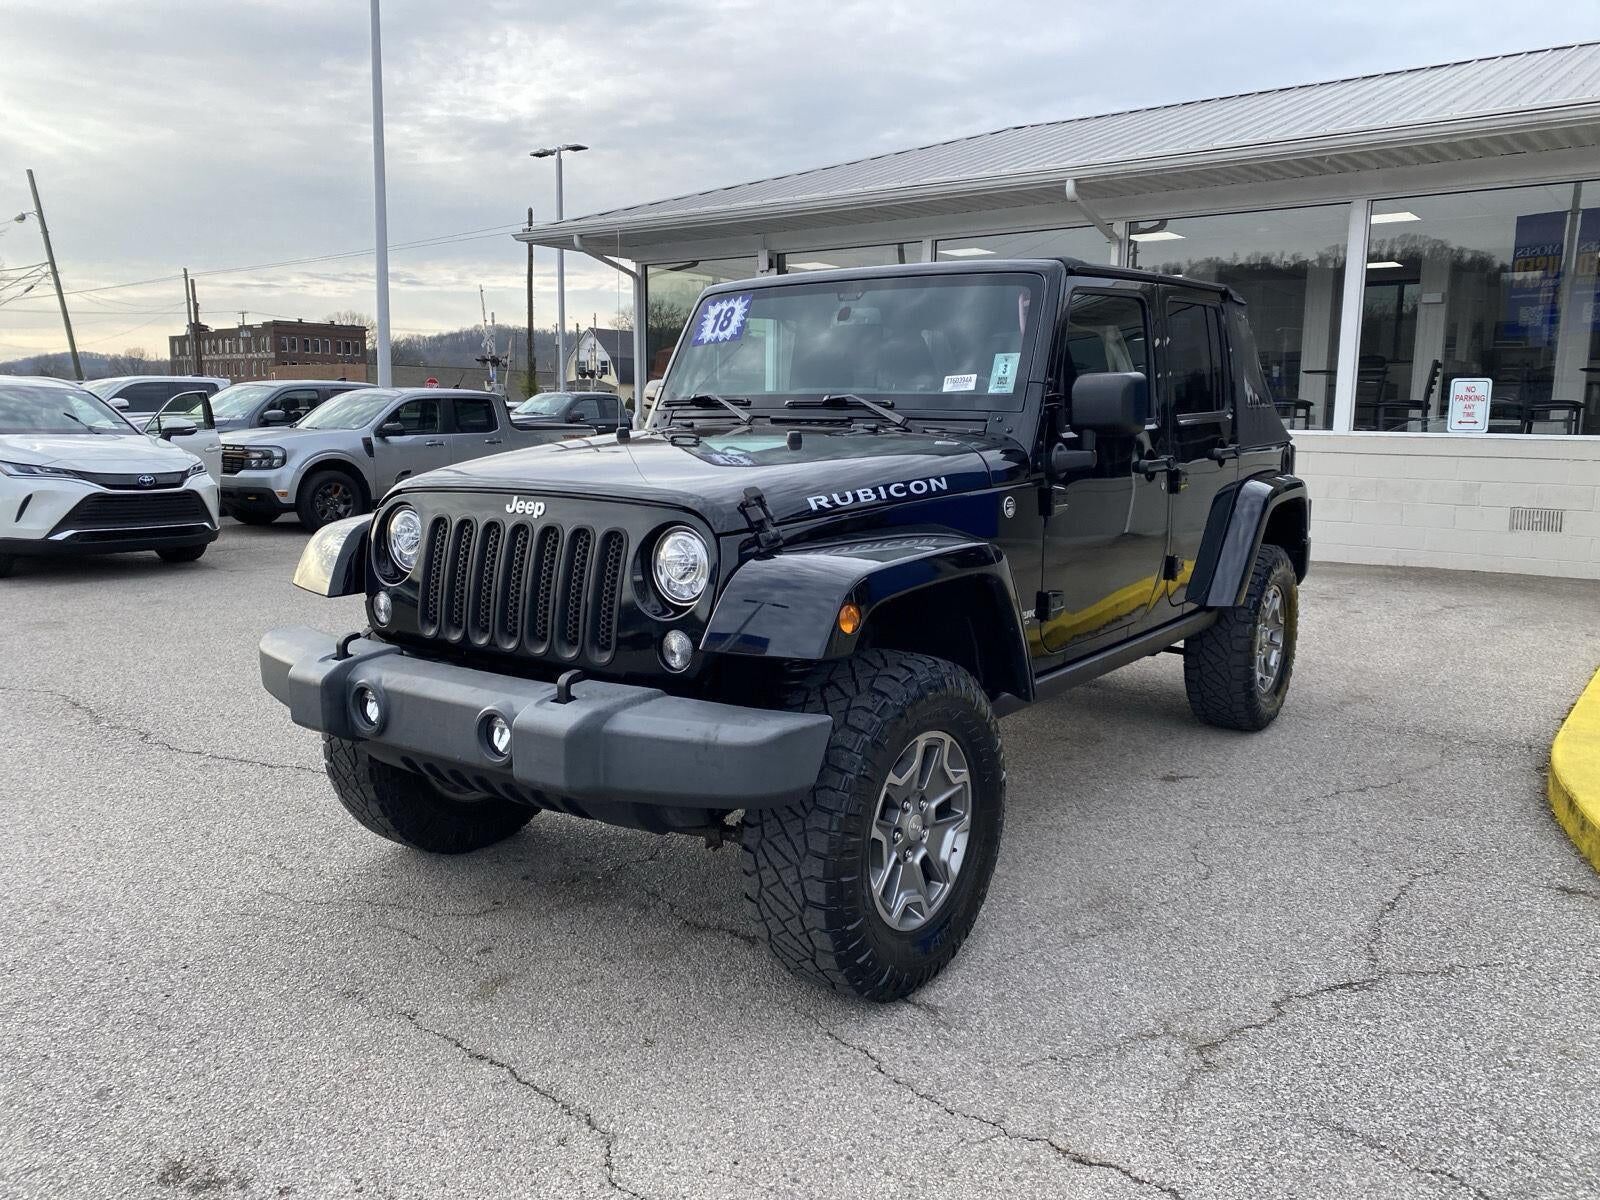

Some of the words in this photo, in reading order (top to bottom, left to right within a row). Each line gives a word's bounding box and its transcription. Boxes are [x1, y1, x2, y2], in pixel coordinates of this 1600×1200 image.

[711, 306, 736, 334] 18
[505, 495, 546, 519] Jeep
[807, 476, 948, 511] RUBICON
